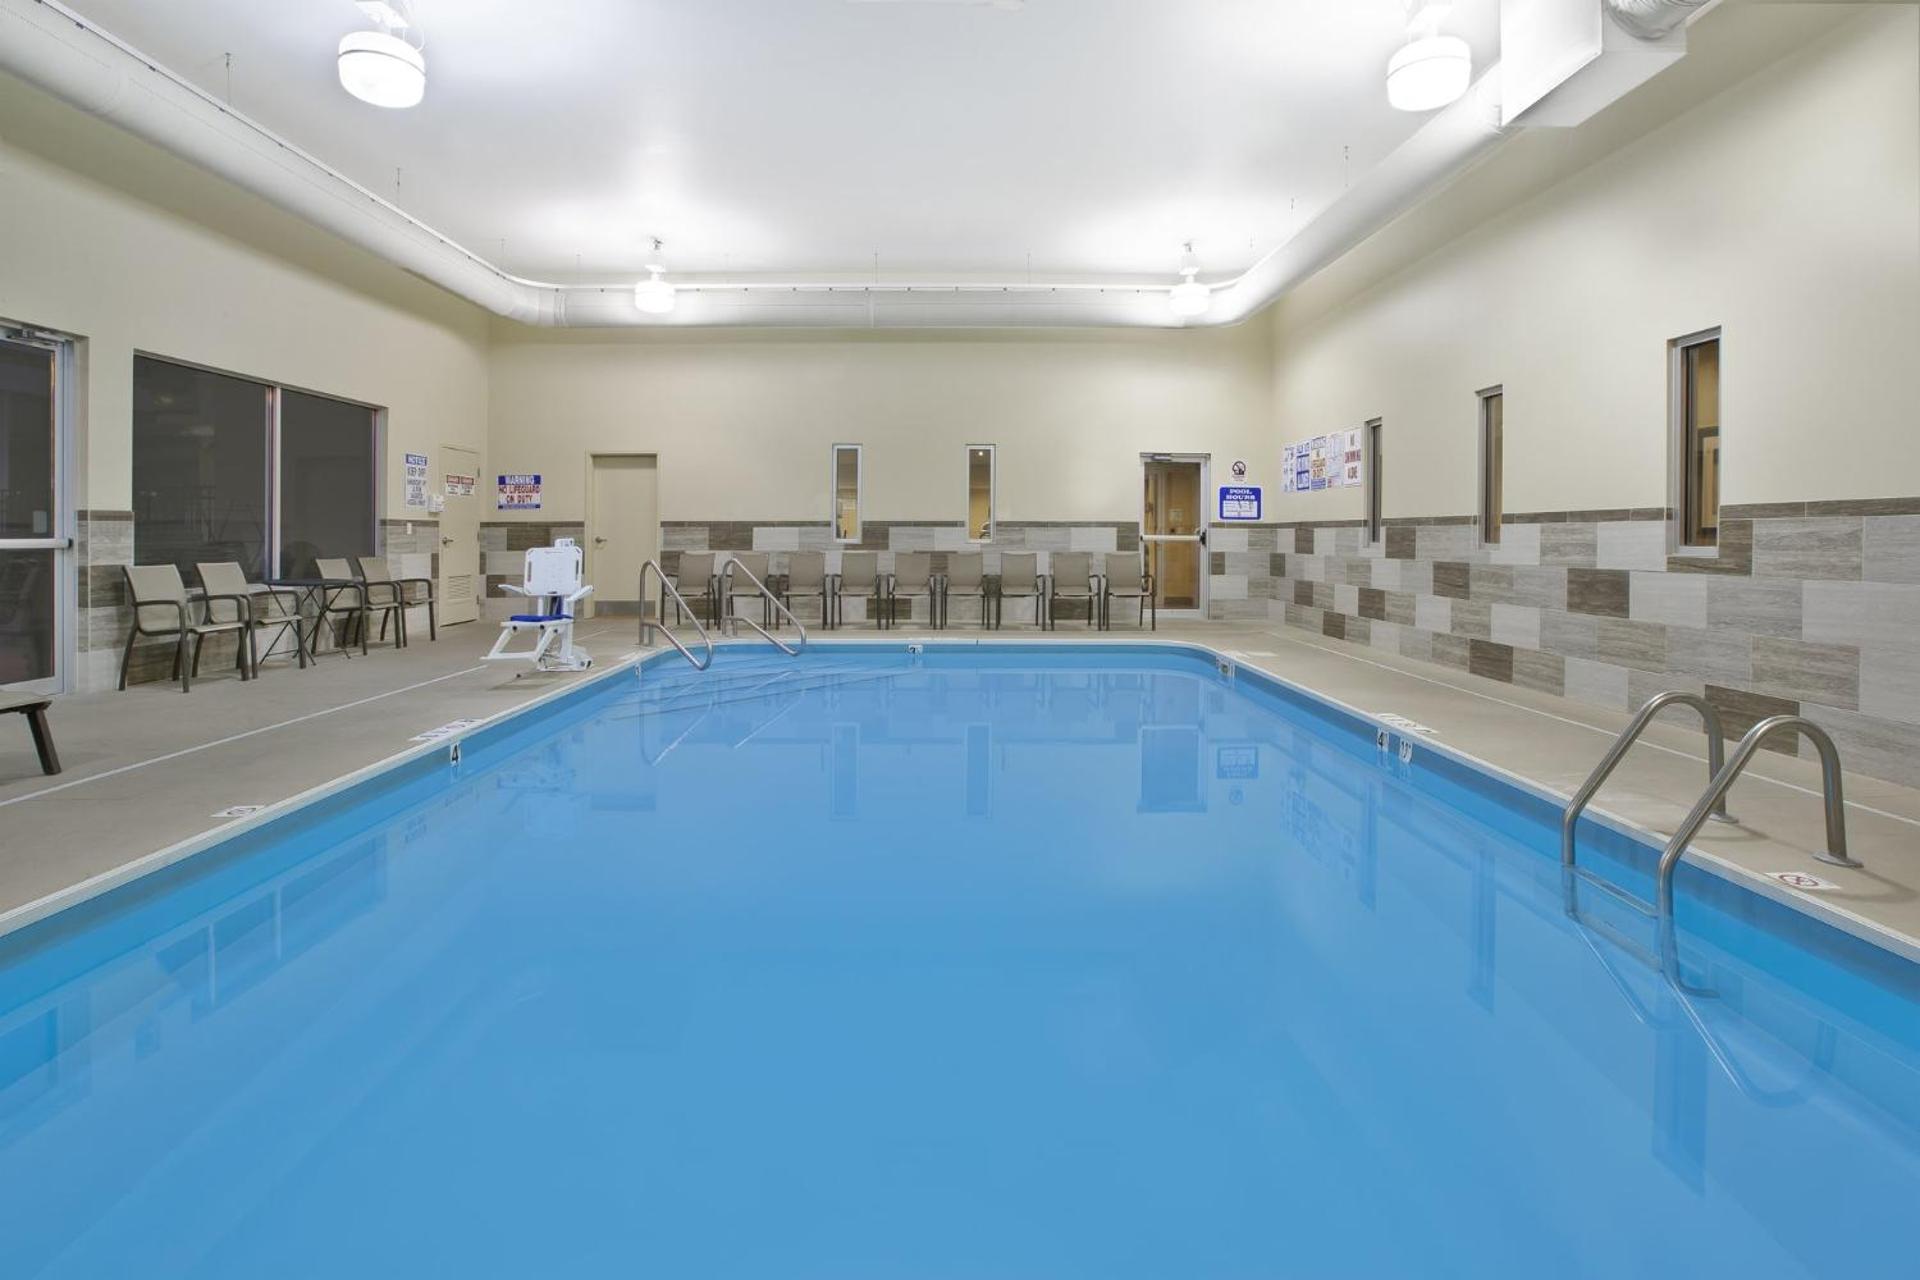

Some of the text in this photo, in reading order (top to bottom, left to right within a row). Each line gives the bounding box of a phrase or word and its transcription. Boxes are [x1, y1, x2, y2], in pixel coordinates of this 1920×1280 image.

[504, 475, 534, 485] WARNING
[498, 485, 540, 494] NO LIFEGUARD
[506, 494, 533, 503] ON DUTY
[451, 744, 459, 763] 4
